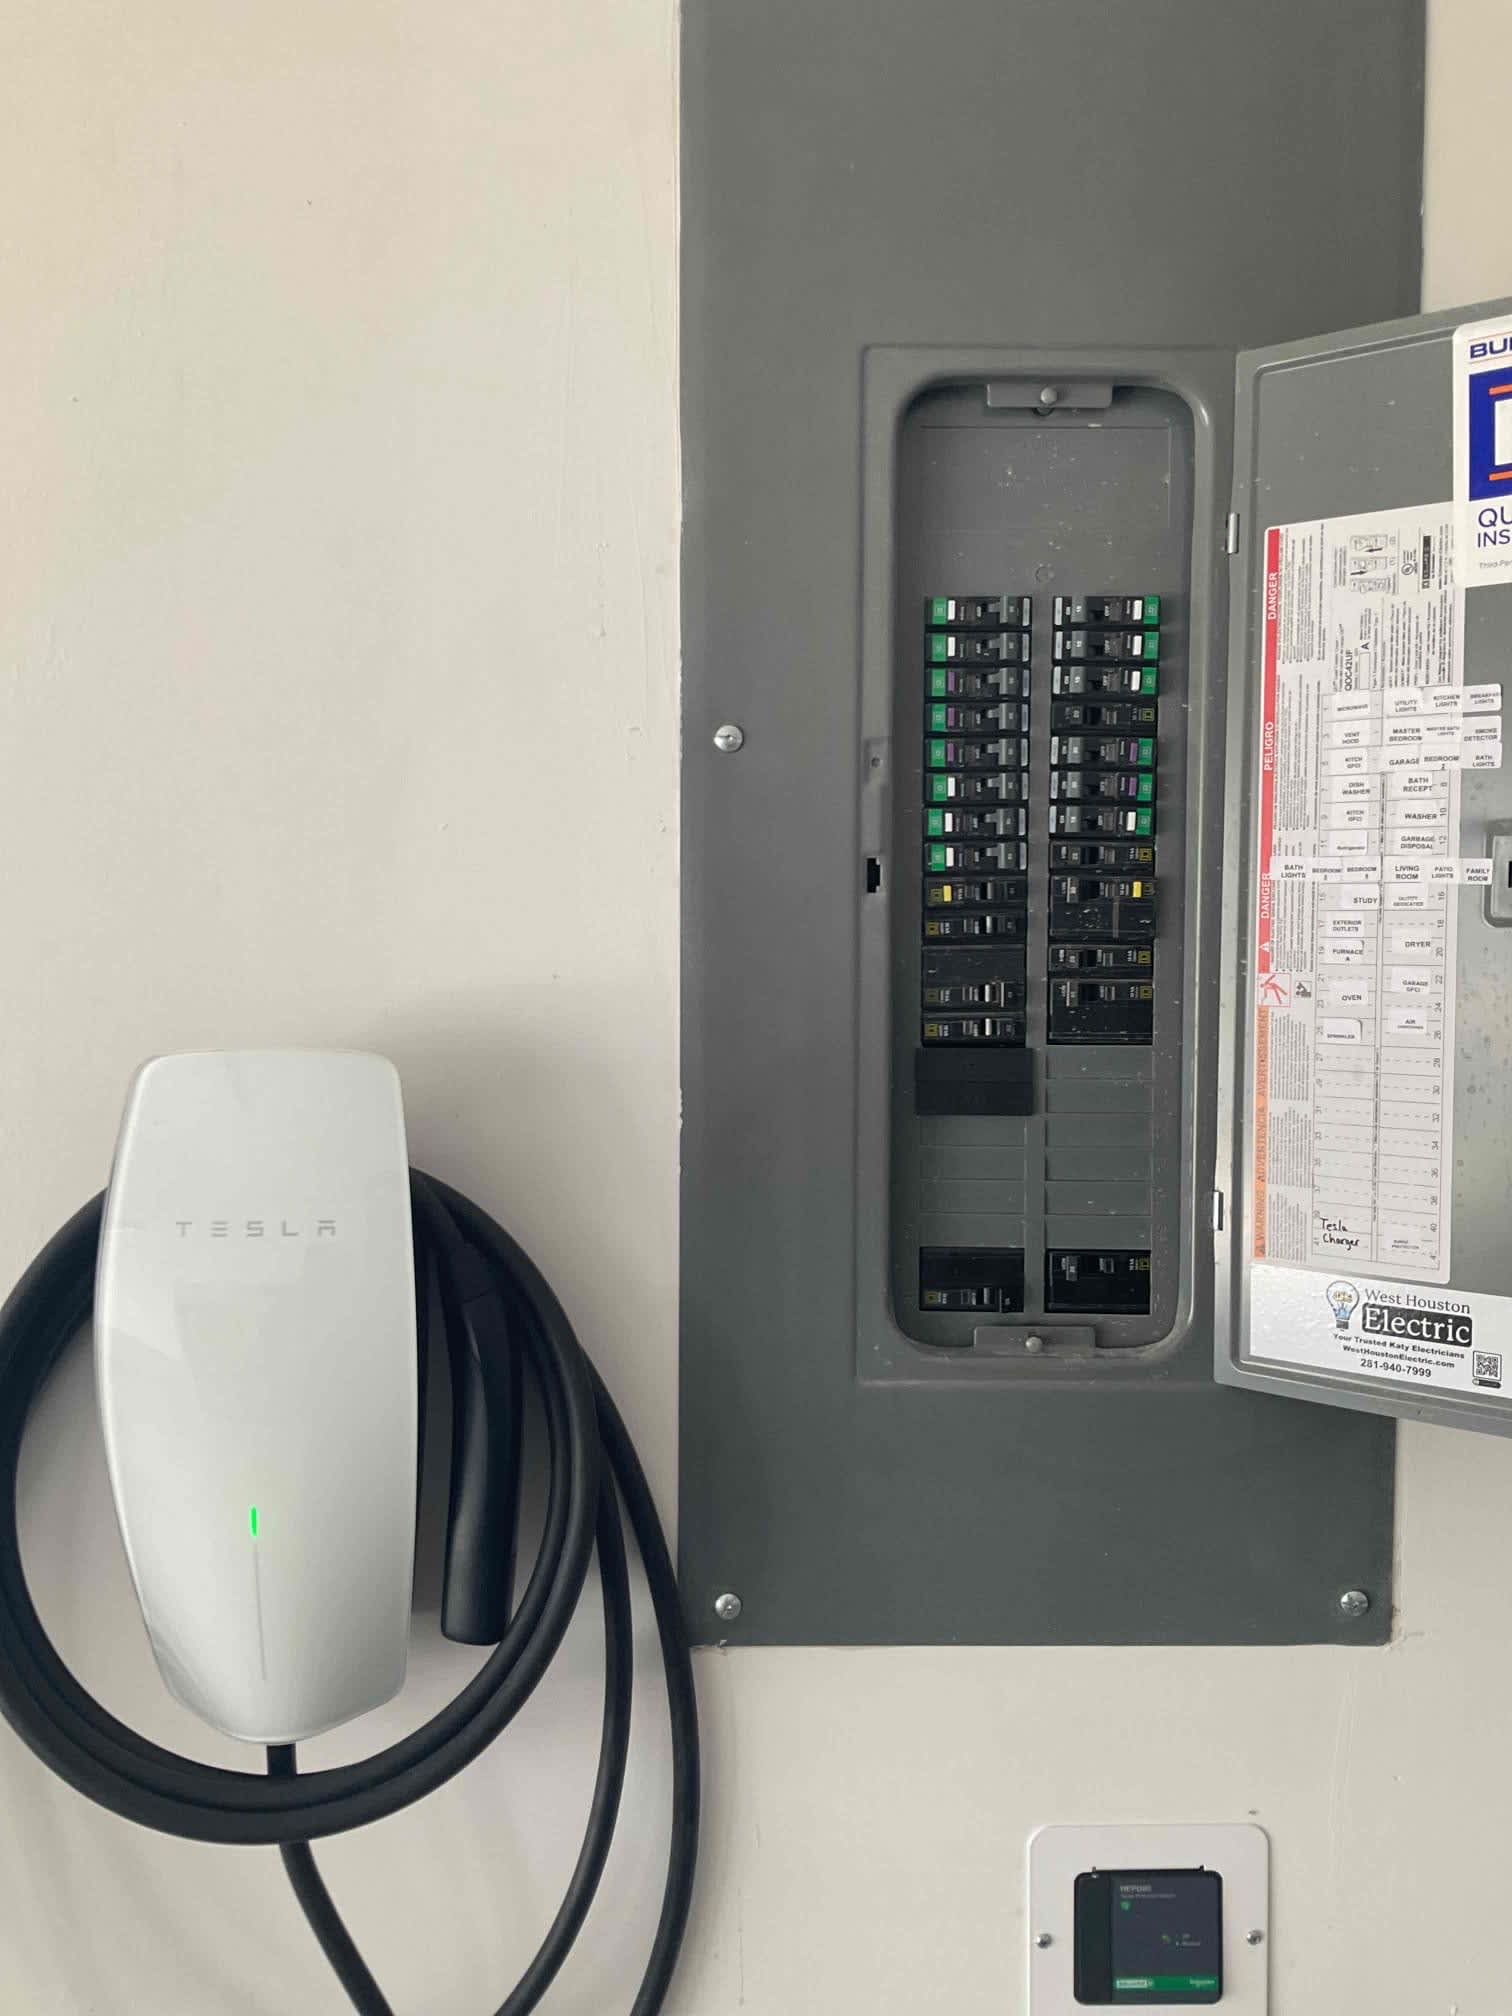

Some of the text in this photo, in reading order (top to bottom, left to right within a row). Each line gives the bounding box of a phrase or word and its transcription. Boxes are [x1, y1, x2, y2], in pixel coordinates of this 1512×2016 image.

[1267, 572, 1279, 620] DANGER
[1435, 700, 1458, 708] LIGHTS
[1263, 721, 1274, 771] PELIGRO
[1389, 758, 1420, 766] GARAGE
[1403, 785, 1433, 793] RECEPT
[1404, 812, 1437, 820] WASHER
[1281, 871, 1306, 879] LIGHTS
[1395, 872, 1419, 880] ROOM
[1466, 867, 1490, 875] FAMILY
[1260, 872, 1270, 919] DANGER
[175, 1219, 337, 1239] TESLA
[1319, 1217, 1349, 1232] Tesla
[1322, 1233, 1360, 1251] Charger
[1364, 1288, 1402, 1305] West
[1406, 1293, 1471, 1314] Houston
[1364, 1306, 1471, 1345] Electric
[1333, 1333, 1465, 1359] Your Trusted Katy Electricians
[1342, 1344, 1455, 1368] WestHoustonElectric.com
[1360, 1358, 1432, 1378] 281-940-7999
